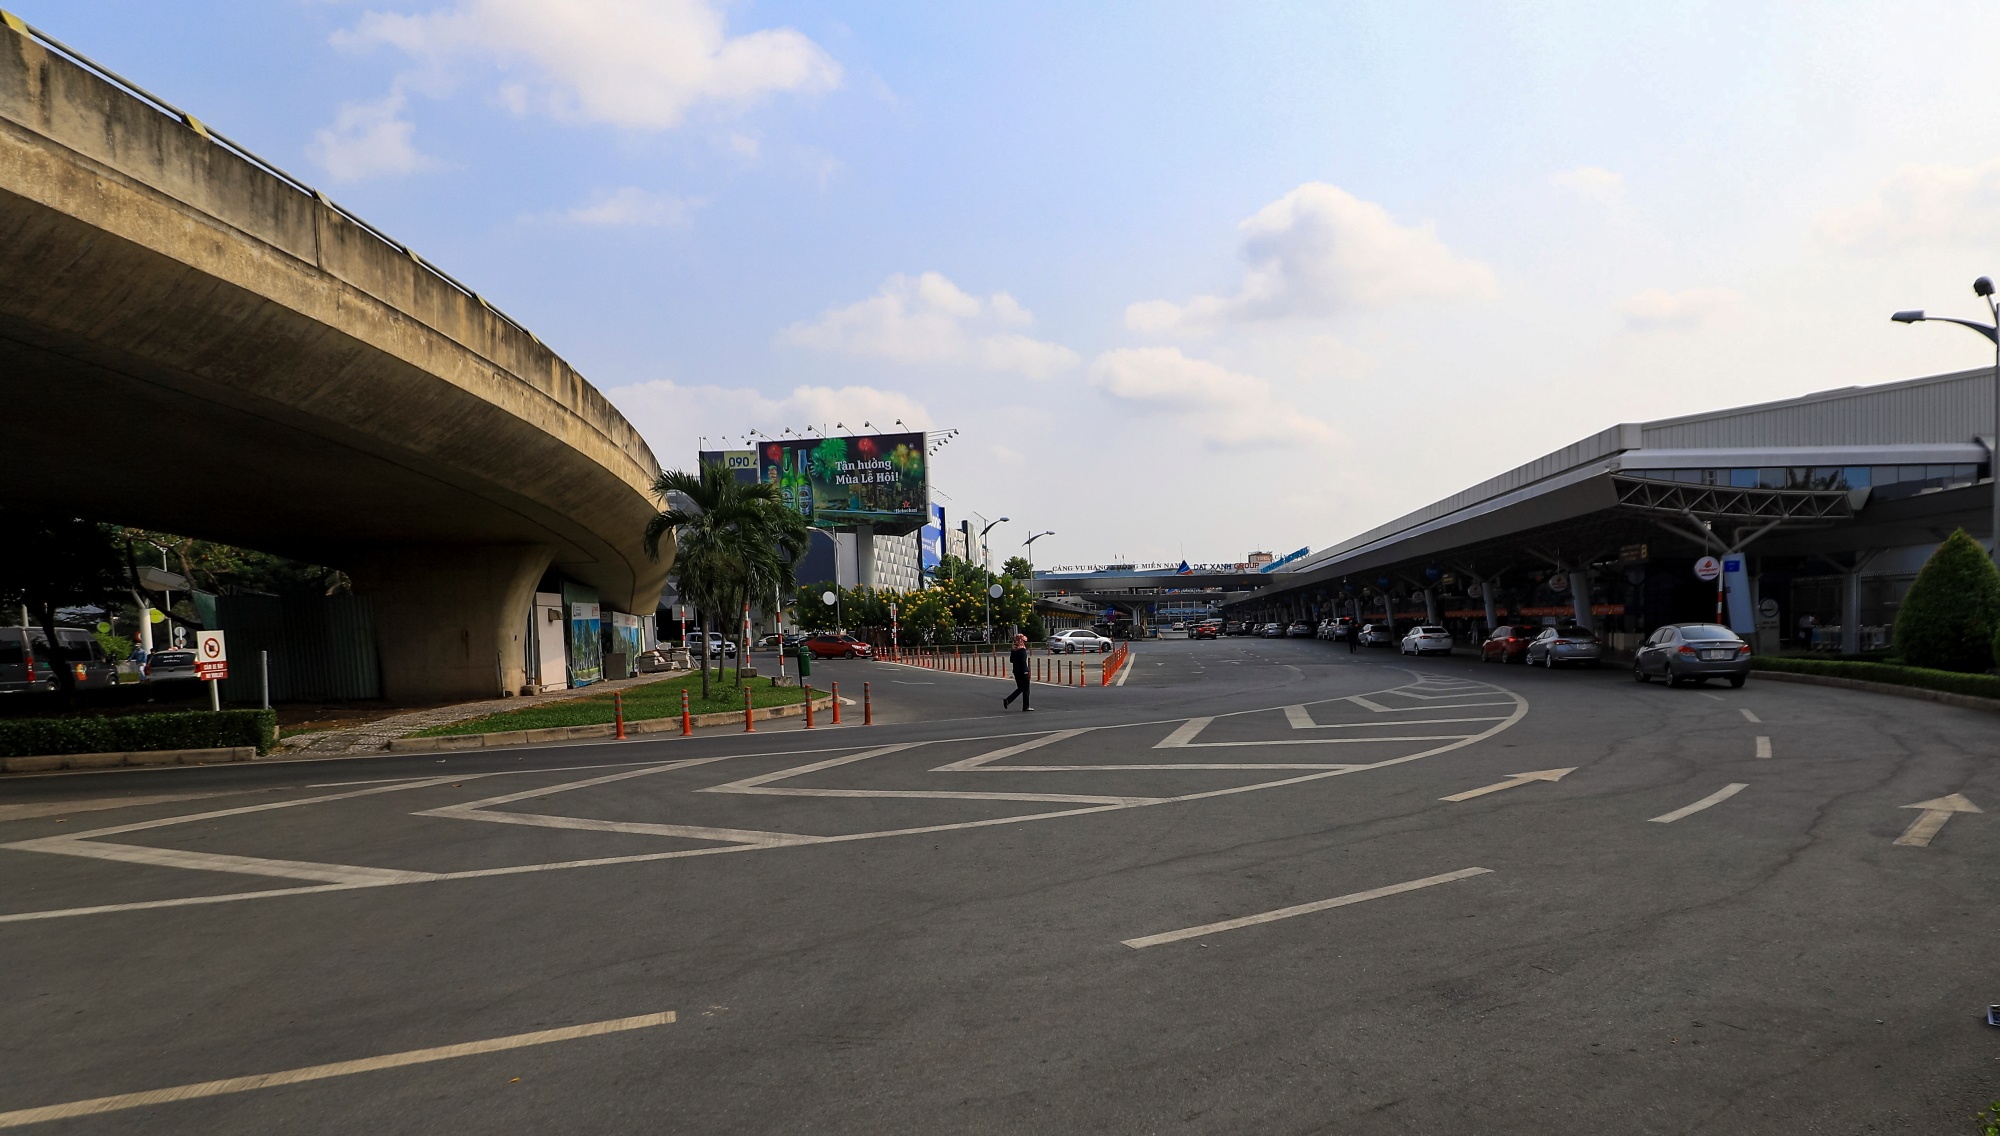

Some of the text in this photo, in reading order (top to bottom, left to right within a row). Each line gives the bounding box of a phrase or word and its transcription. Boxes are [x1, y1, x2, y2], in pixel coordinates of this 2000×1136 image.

[728, 457, 750, 467] 090
[835, 457, 892, 473] Tận hưởng
[836, 470, 899, 485] Mùa Lễ Hội!
[1234, 562, 1260, 570] GROUP
